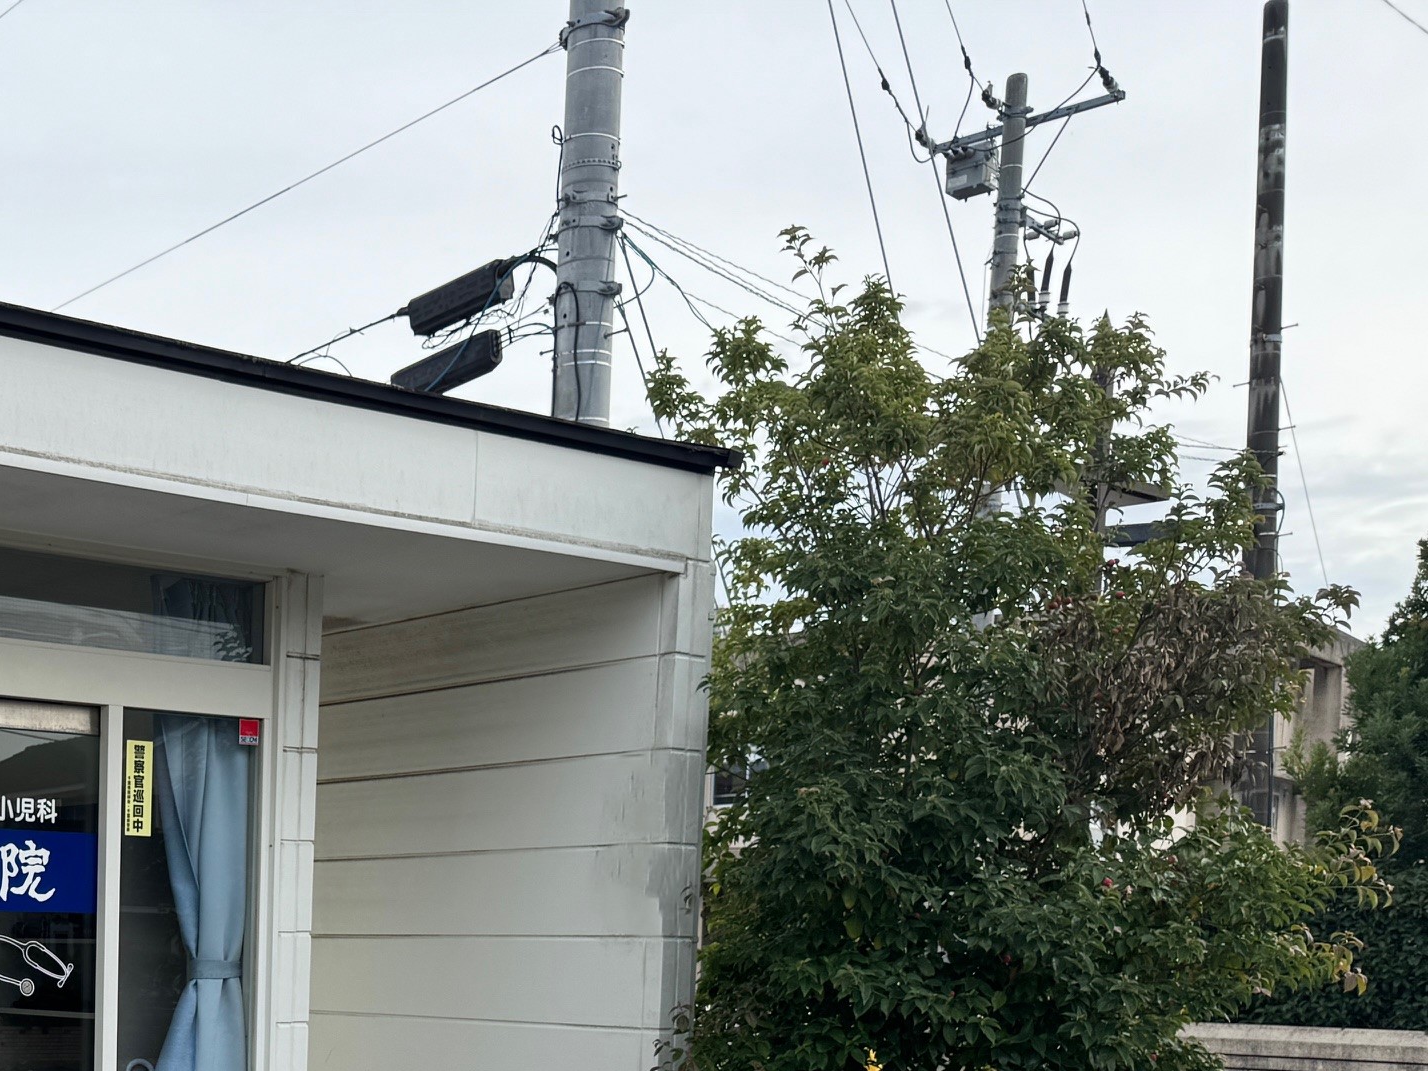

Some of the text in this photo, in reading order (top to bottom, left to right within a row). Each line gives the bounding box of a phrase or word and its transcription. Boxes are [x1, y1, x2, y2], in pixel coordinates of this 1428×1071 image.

[133, 744, 146, 832] 警察官巡回中
